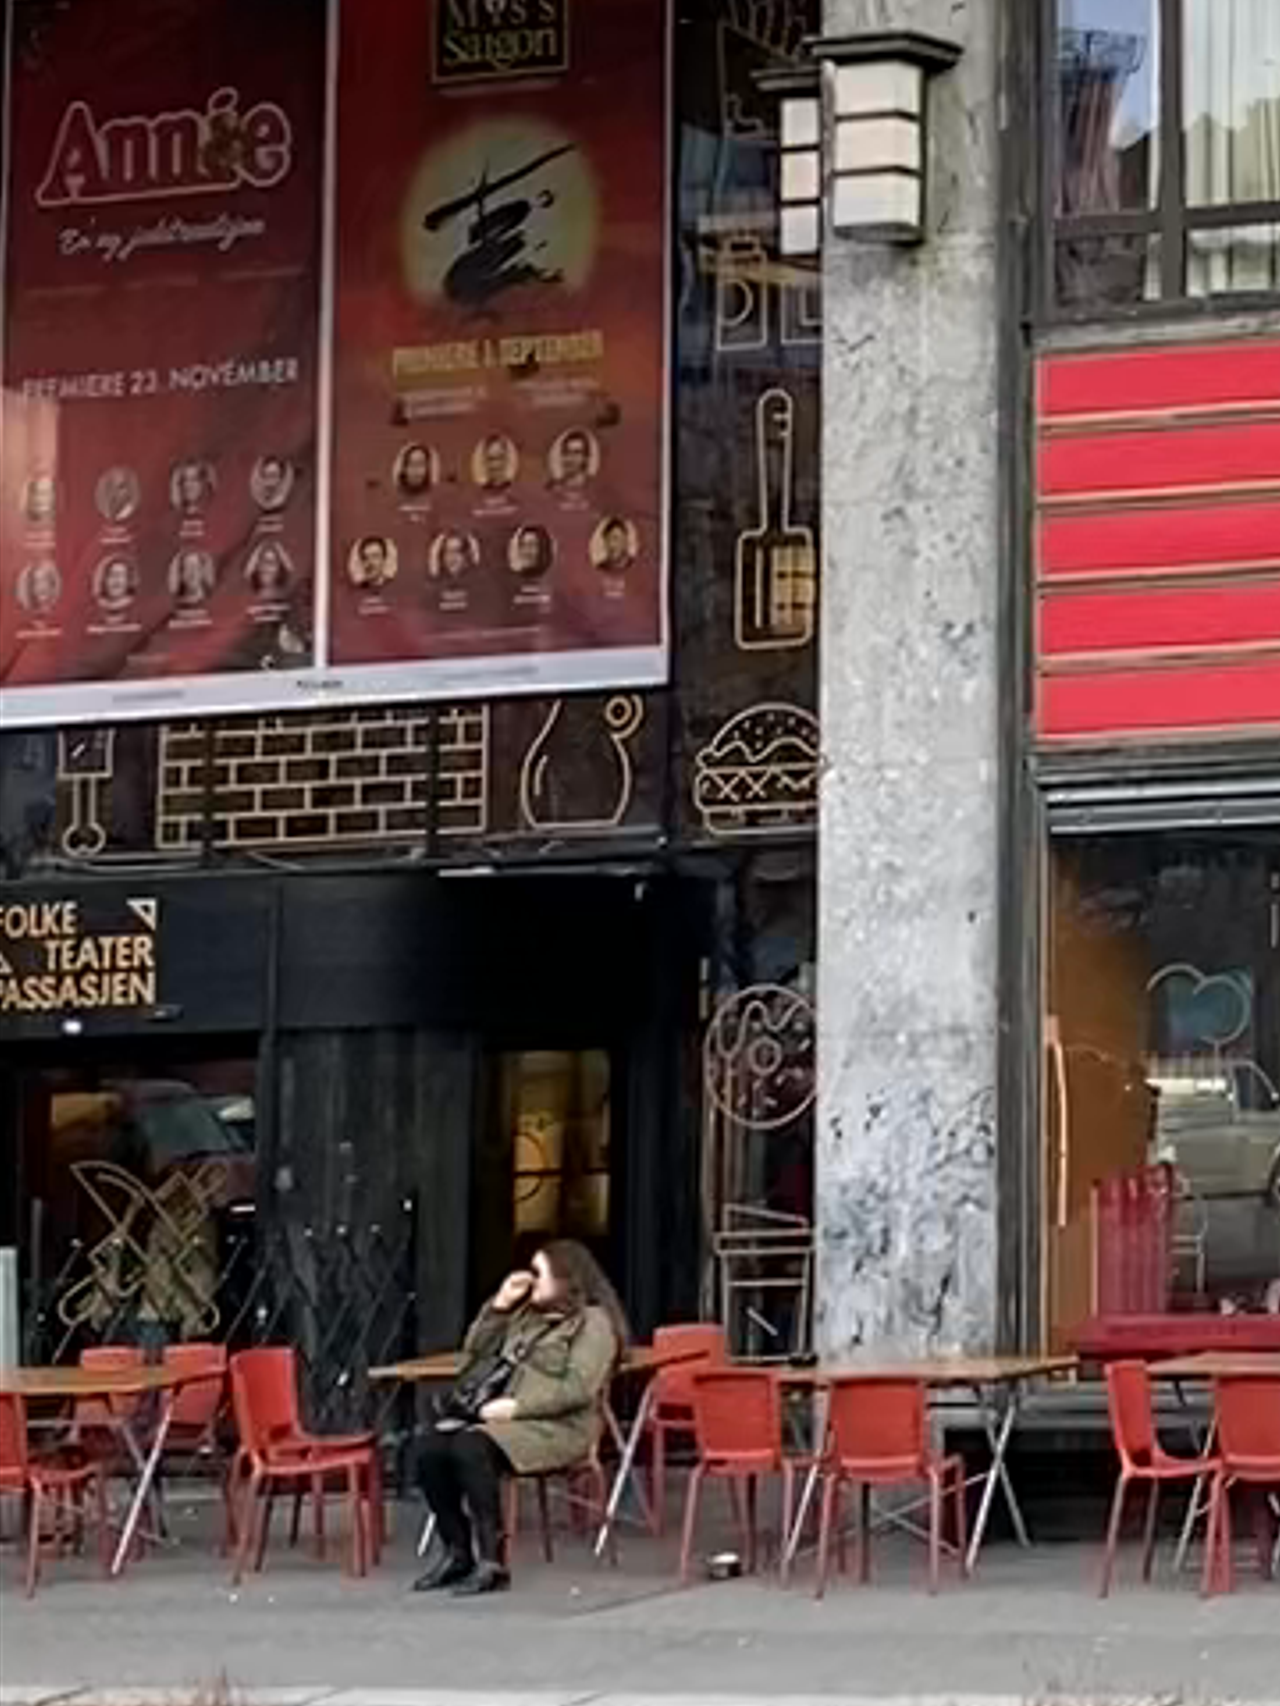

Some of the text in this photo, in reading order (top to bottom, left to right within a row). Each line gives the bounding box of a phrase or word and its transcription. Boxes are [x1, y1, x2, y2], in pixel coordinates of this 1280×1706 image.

[35, 86, 291, 205] Annie
[169, 356, 298, 392] NOVEMBER
[0, 900, 78, 939] OLKE
[45, 935, 155, 971] TEATER
